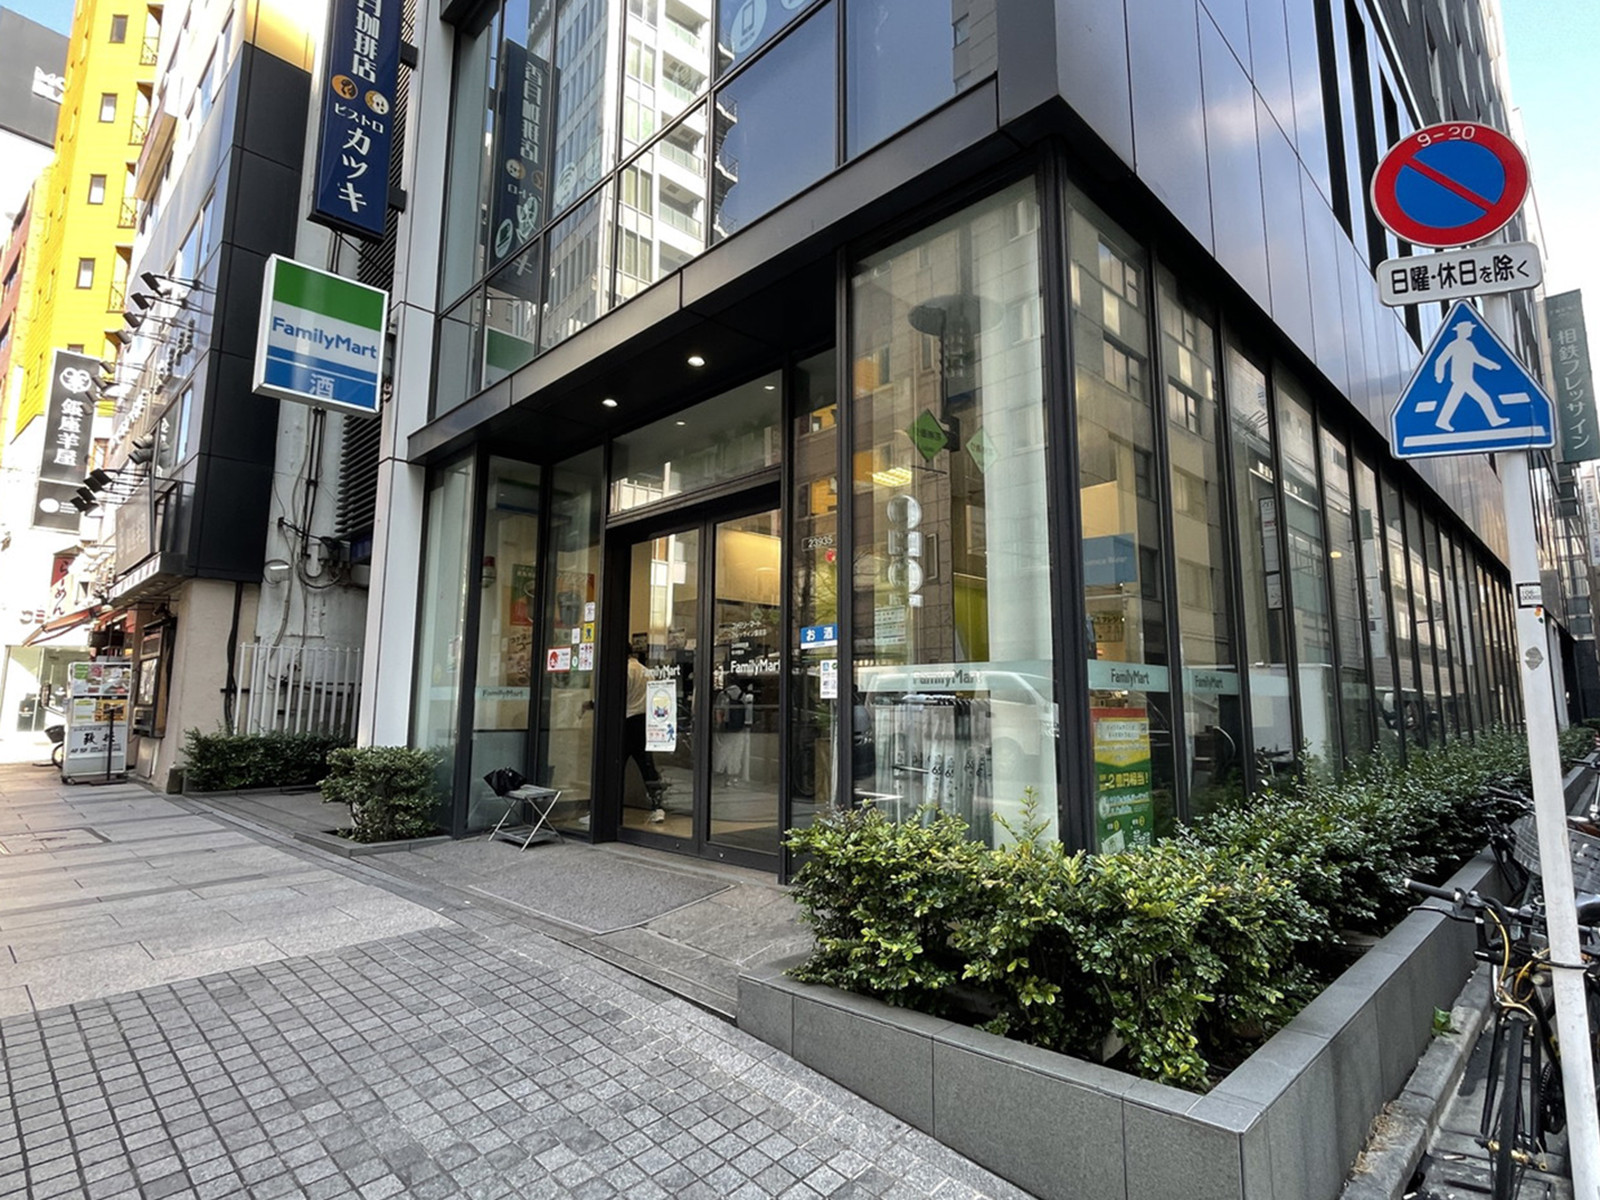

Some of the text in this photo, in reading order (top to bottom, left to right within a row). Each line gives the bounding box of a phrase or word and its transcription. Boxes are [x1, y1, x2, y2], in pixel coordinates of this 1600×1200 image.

[334, 102, 384, 134] ビストロ
[1416, 125, 1476, 148] 9-20
[338, 127, 371, 212] カツキ
[1391, 254, 1530, 295] 日曜・休日を除く
[272, 316, 377, 359] FamilyMart
[309, 373, 335, 399] 酒
[1557, 328, 1591, 451] 相鉄フレッサイン
[808, 535, 833, 548] 23935
[1110, 668, 1150, 687] FamilyMart
